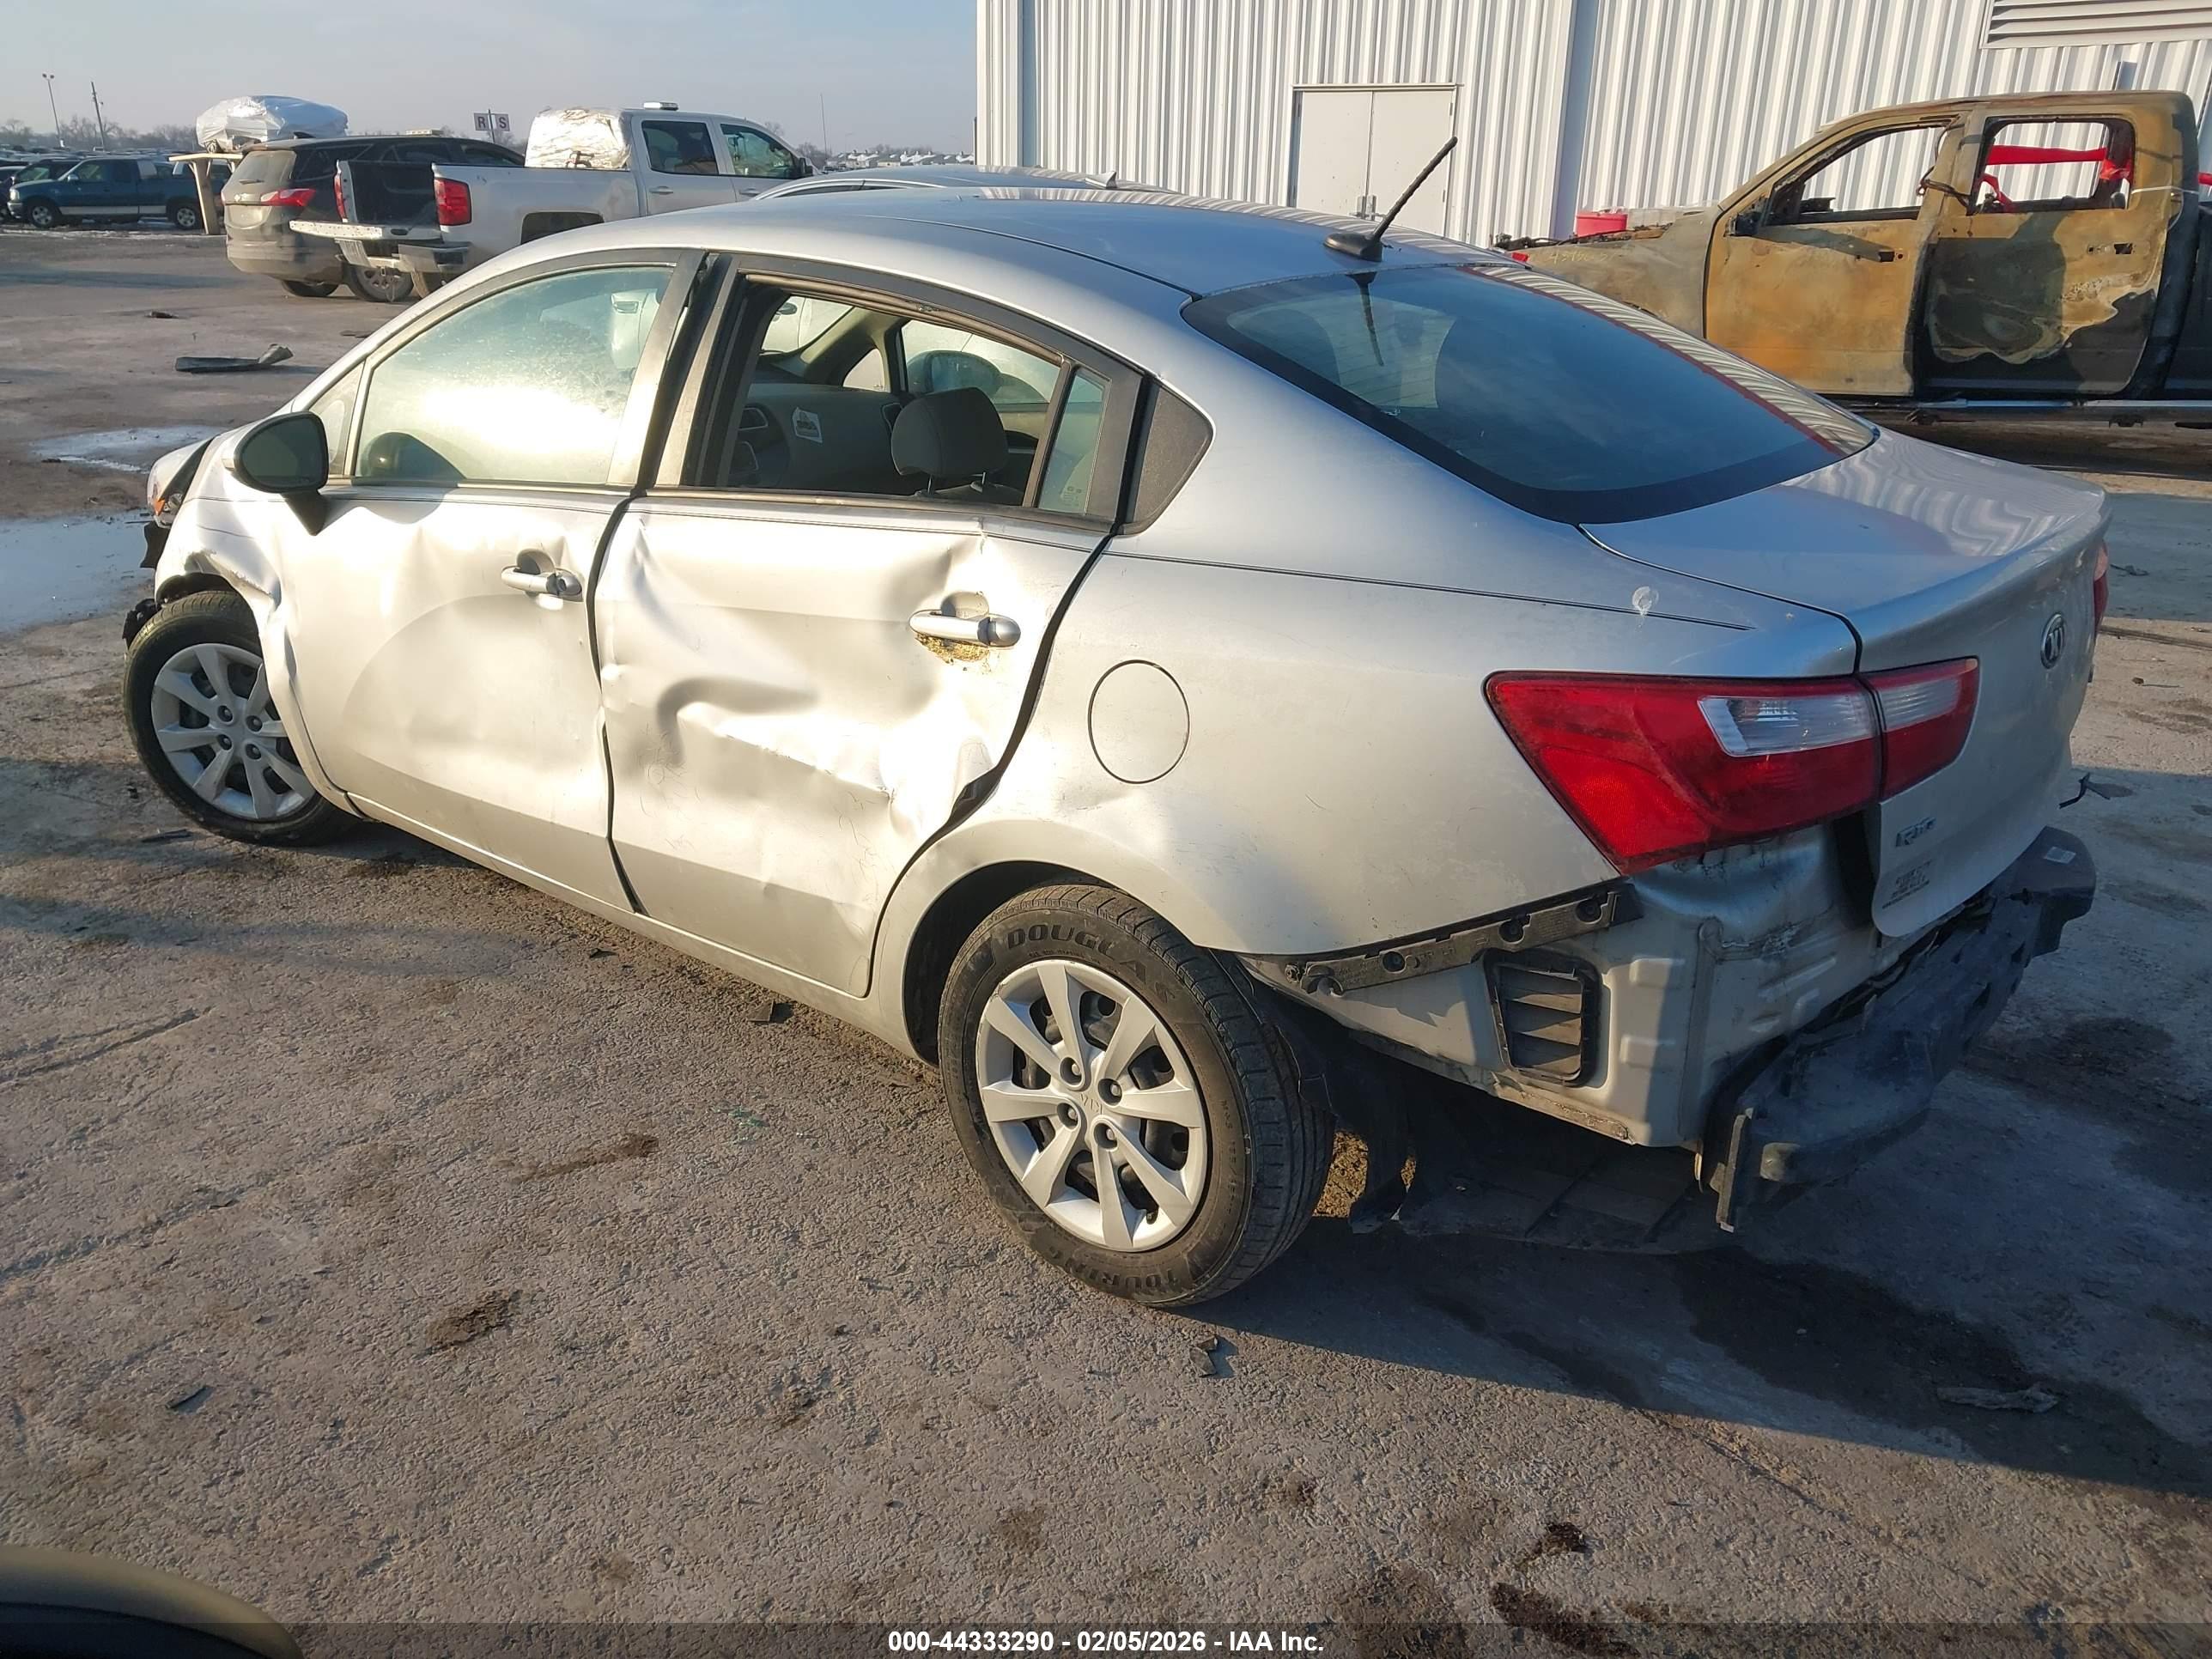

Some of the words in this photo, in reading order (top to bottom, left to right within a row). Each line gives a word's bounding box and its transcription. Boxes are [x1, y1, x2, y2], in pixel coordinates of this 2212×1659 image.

[477, 117, 486, 128] R
[498, 117, 507, 129] S
[1007, 924, 1176, 1004] DOUGLAS
